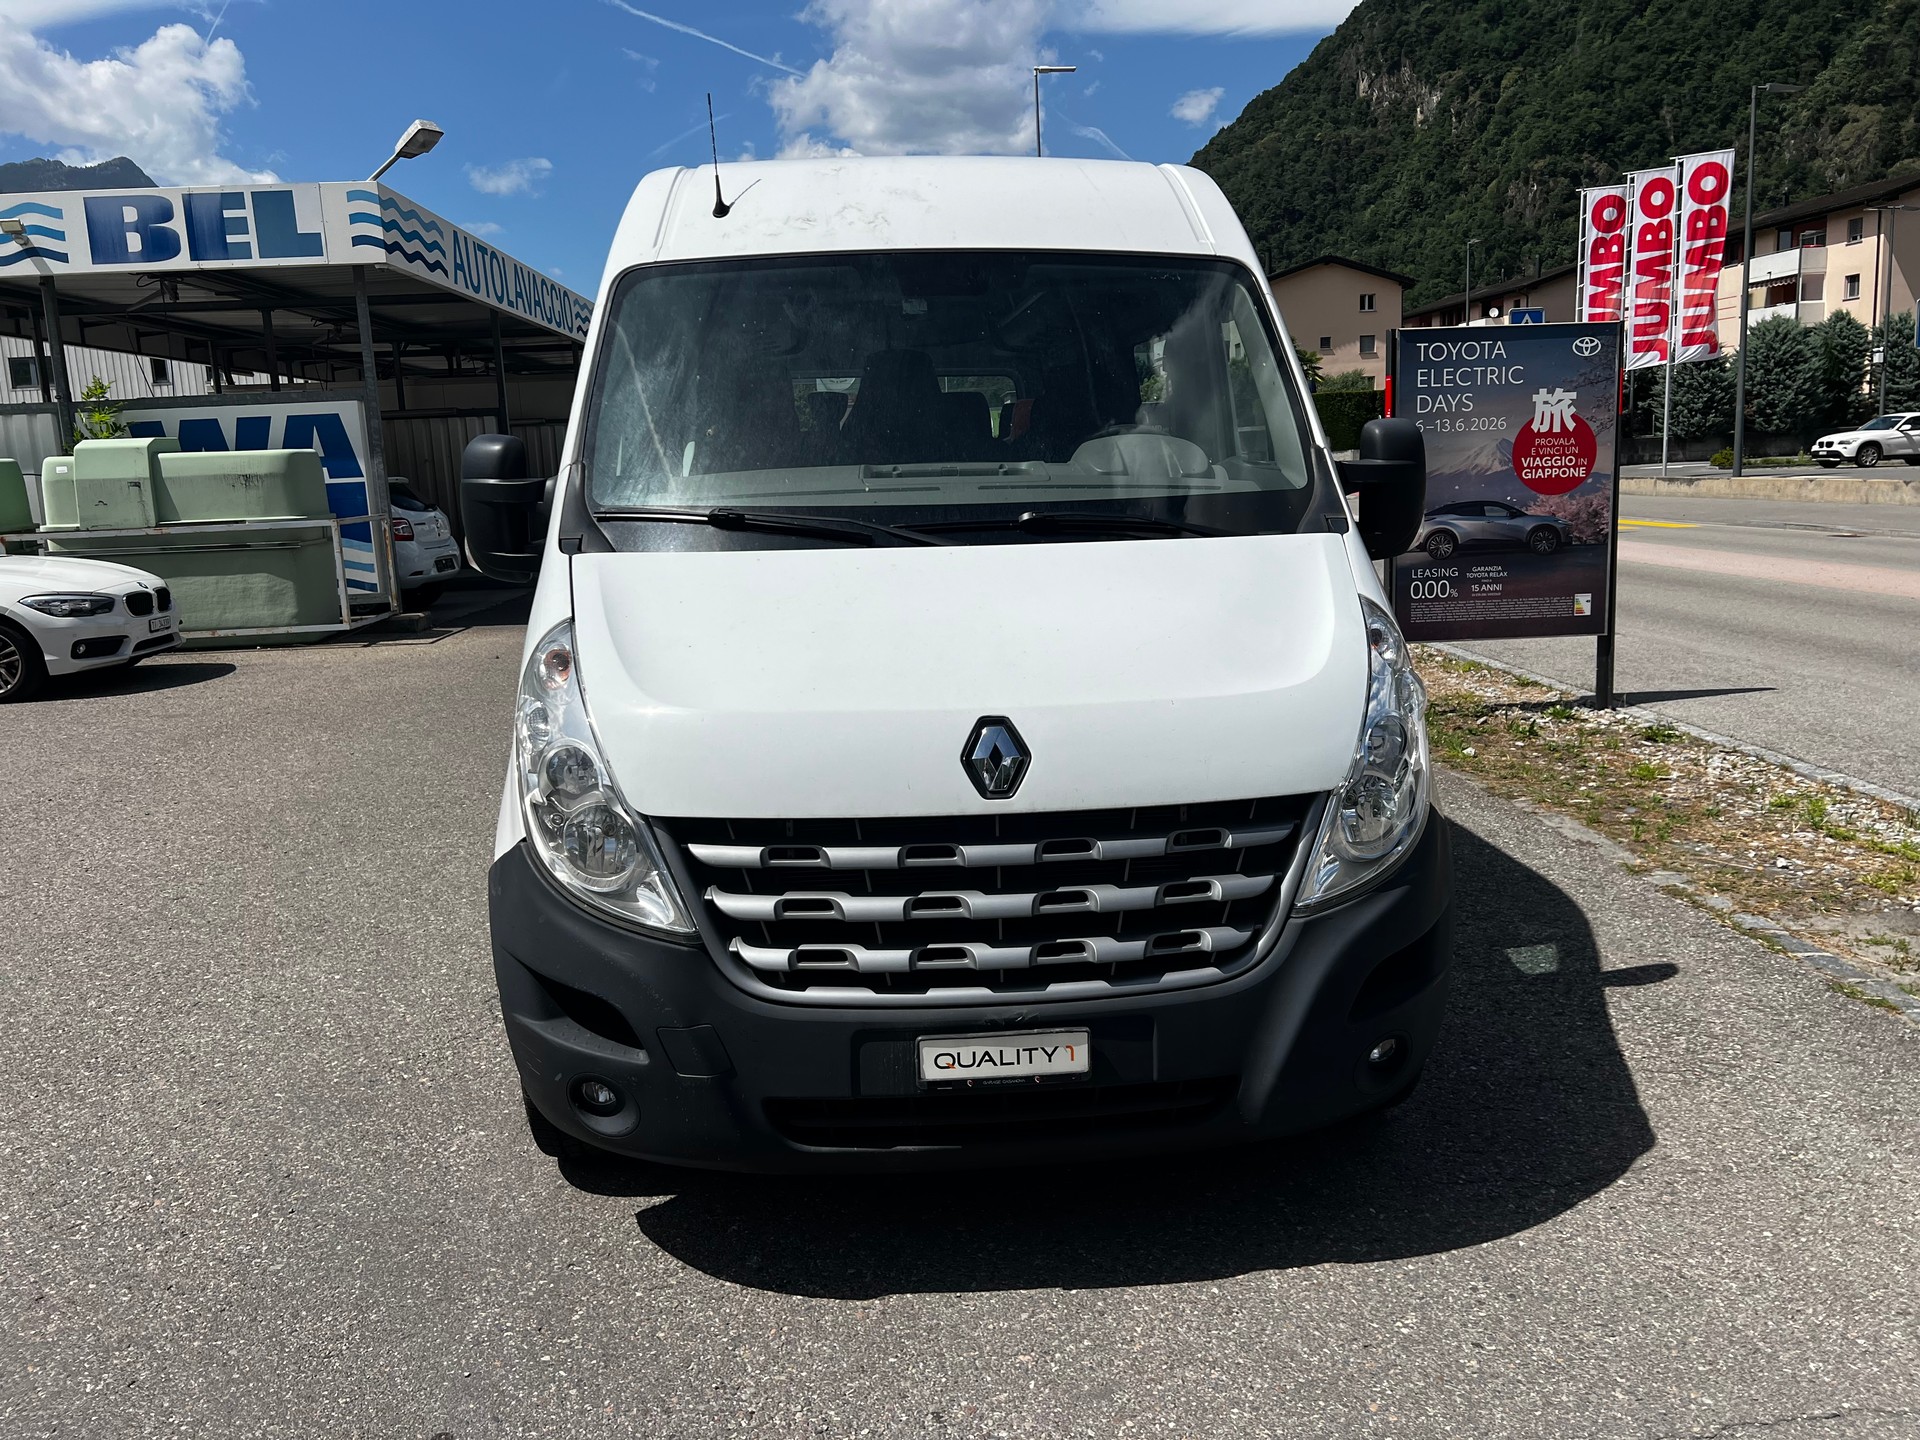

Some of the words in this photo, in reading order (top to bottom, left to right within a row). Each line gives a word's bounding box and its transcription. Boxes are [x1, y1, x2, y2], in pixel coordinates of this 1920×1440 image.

[83, 190, 324, 265] BEL
[1681, 161, 1729, 354] JUMBO
[1633, 177, 1675, 361] JUMBO
[1416, 340, 1507, 361] TOYOTA
[1417, 365, 1524, 387] ELECTRIC
[1416, 393, 1474, 413] DAYS
[1531, 387, 1577, 433] 旅
[1535, 437, 1576, 446] PROVALA
[1531, 447, 1536, 456] E
[1538, 446, 1563, 455] VINCI
[1565, 446, 1579, 454] UN
[1521, 456, 1576, 467] VIAGGIO
[1577, 458, 1588, 466] IN
[1521, 467, 1587, 479] GIAPPONE
[1411, 567, 1459, 579] LEASING
[1471, 565, 1503, 573] GARANZIA
[1471, 584, 1480, 592] 15
[1480, 583, 1503, 592] ANNI
